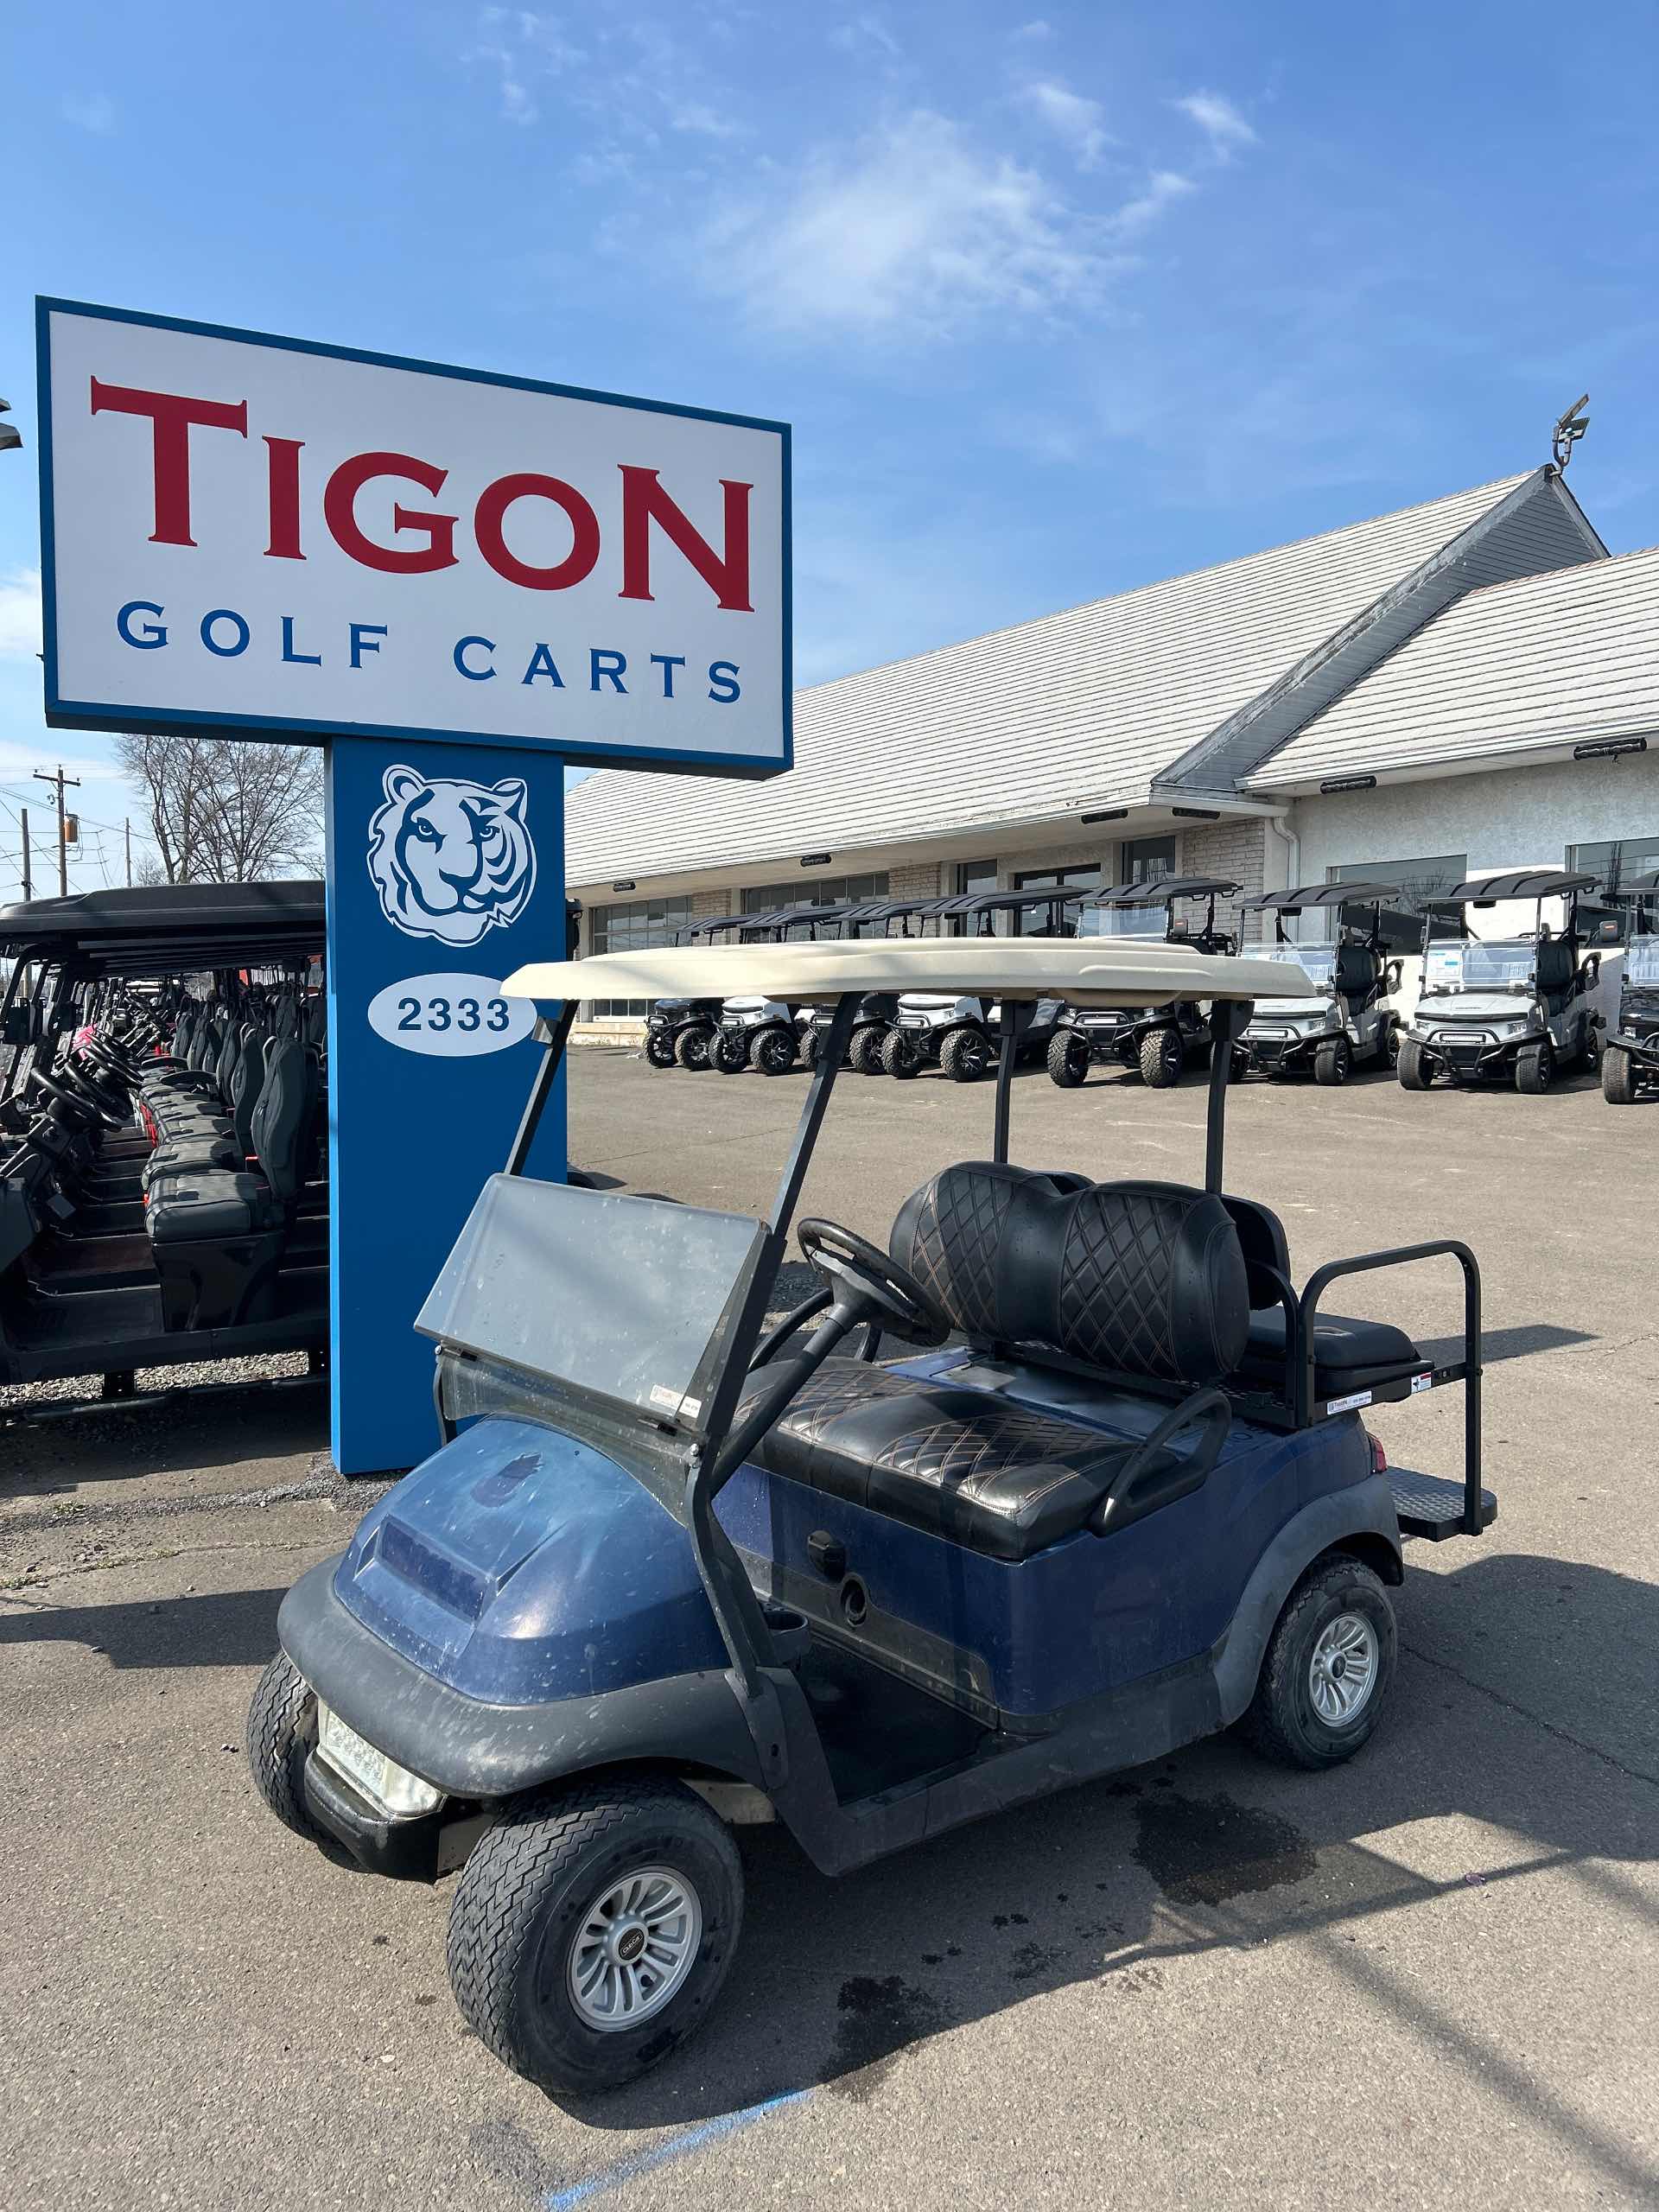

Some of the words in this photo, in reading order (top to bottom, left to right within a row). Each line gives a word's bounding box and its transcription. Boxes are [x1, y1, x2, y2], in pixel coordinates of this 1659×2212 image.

[91, 375, 755, 613] TIGON
[117, 601, 388, 669] GOLF
[453, 635, 741, 704] CARTS
[397, 997, 510, 1032] 2333
